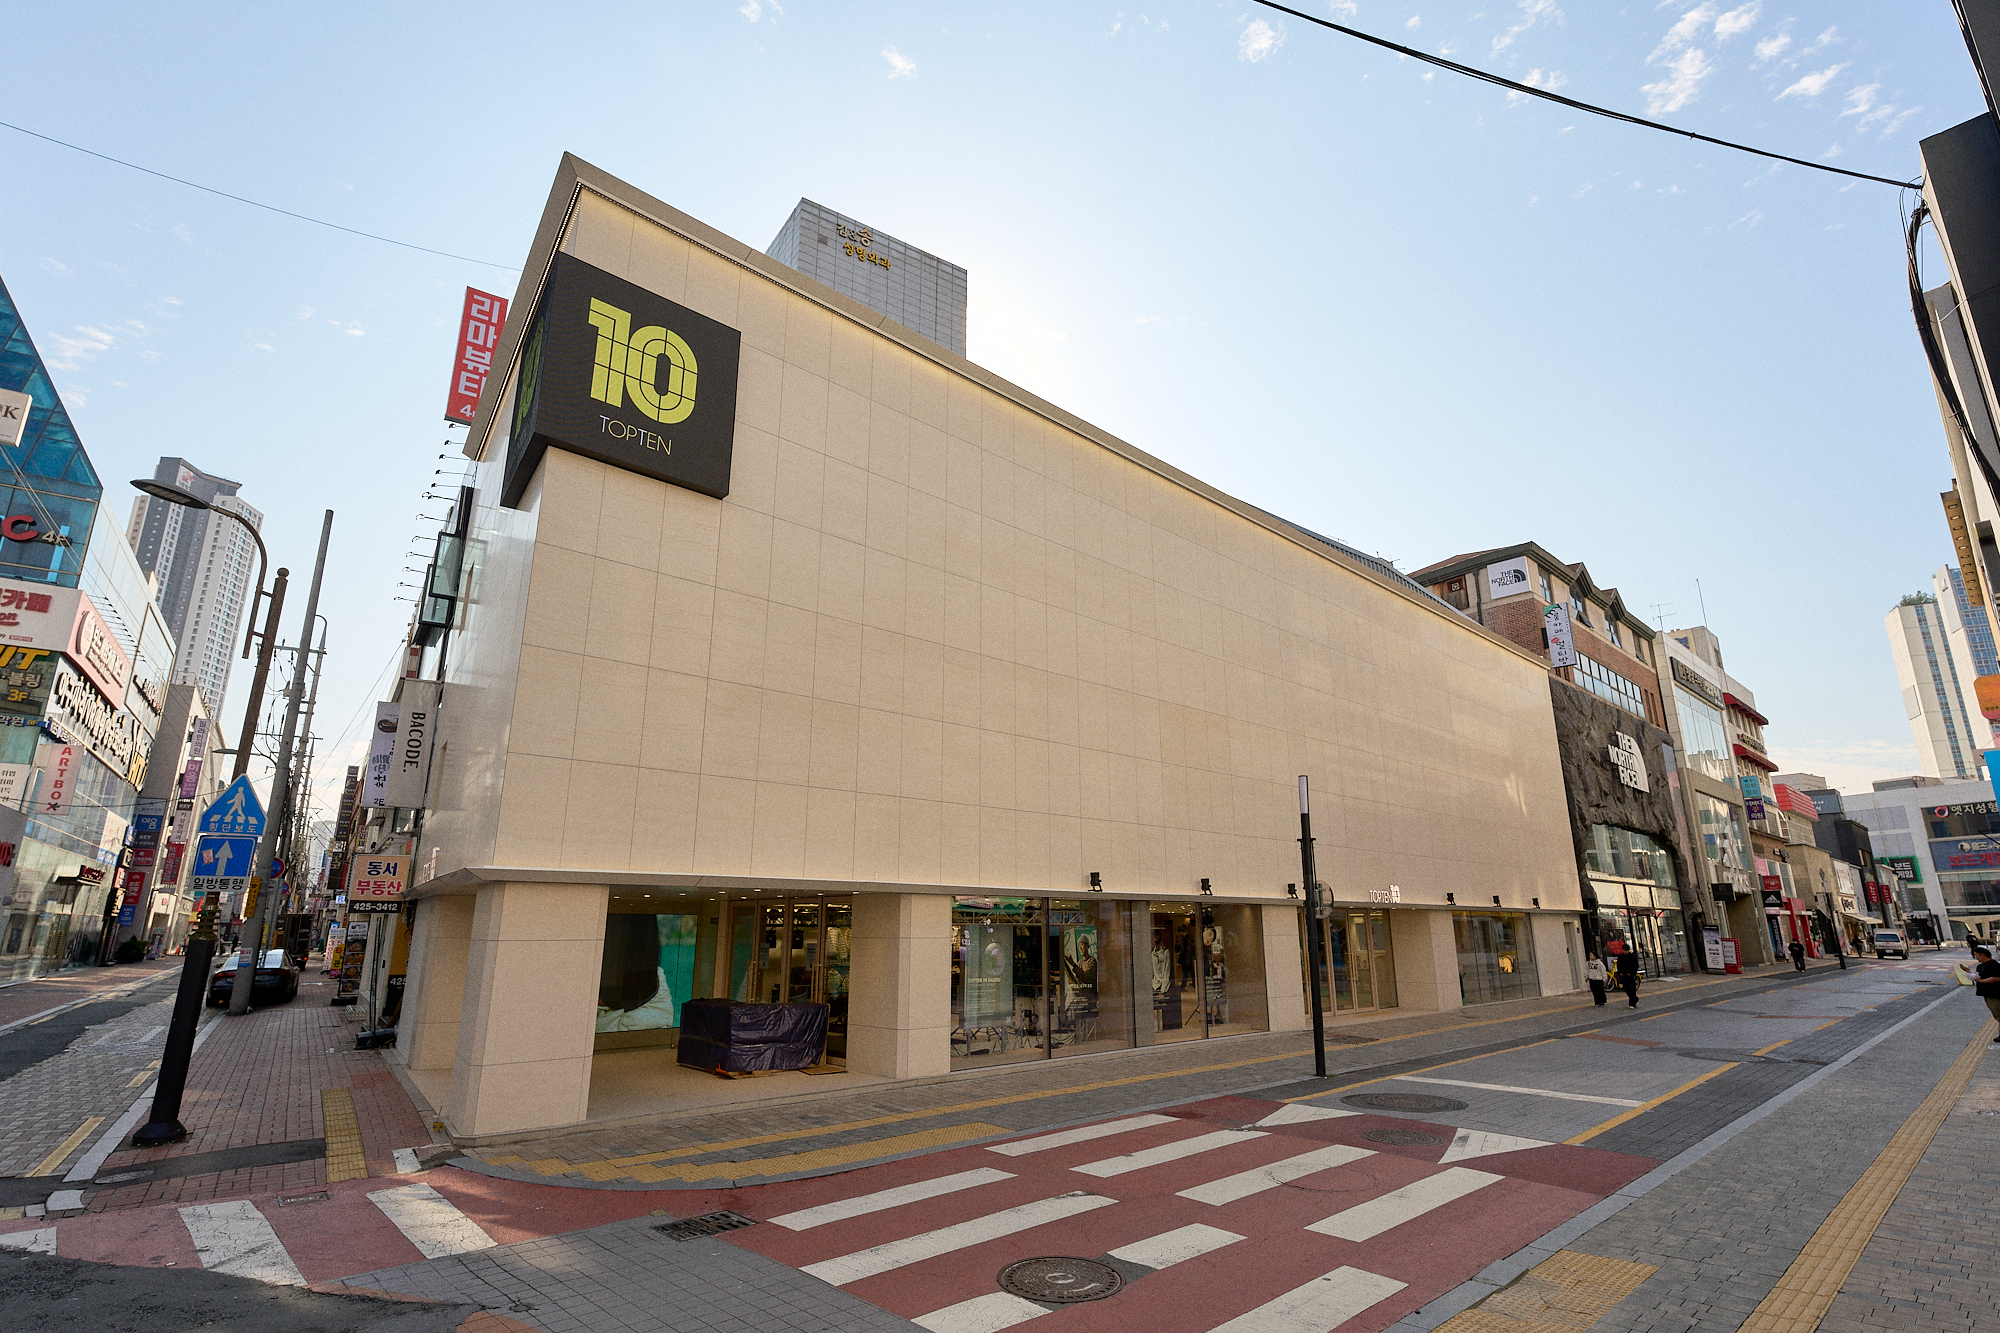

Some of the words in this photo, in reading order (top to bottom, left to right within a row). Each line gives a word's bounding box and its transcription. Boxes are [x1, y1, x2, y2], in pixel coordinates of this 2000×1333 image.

[837, 223, 874, 247] 김&송
[843, 242, 891, 270] 성형외과
[458, 294, 500, 399] 리마뷰티
[588, 296, 698, 425] 10
[460, 404, 476, 418] 4
[600, 414, 672, 456] TOPTEN
[1491, 575, 1514, 585] NORTH
[0, 588, 52, 613] 카페
[7, 688, 29, 701] 3F
[1615, 730, 1633, 753] THE
[1608, 744, 1636, 772] NORTH
[46, 746, 73, 811] ARTBOX
[209, 823, 257, 833] 횡단보도
[367, 861, 398, 877] 동서
[1894, 861, 1912, 870] 보드
[1895, 870, 1914, 879] 게임
[193, 877, 244, 890] 일방통행
[356, 880, 402, 897] 부동산
[1369, 889, 1391, 903] TOPTEN
[353, 902, 398, 911] 425-3412
